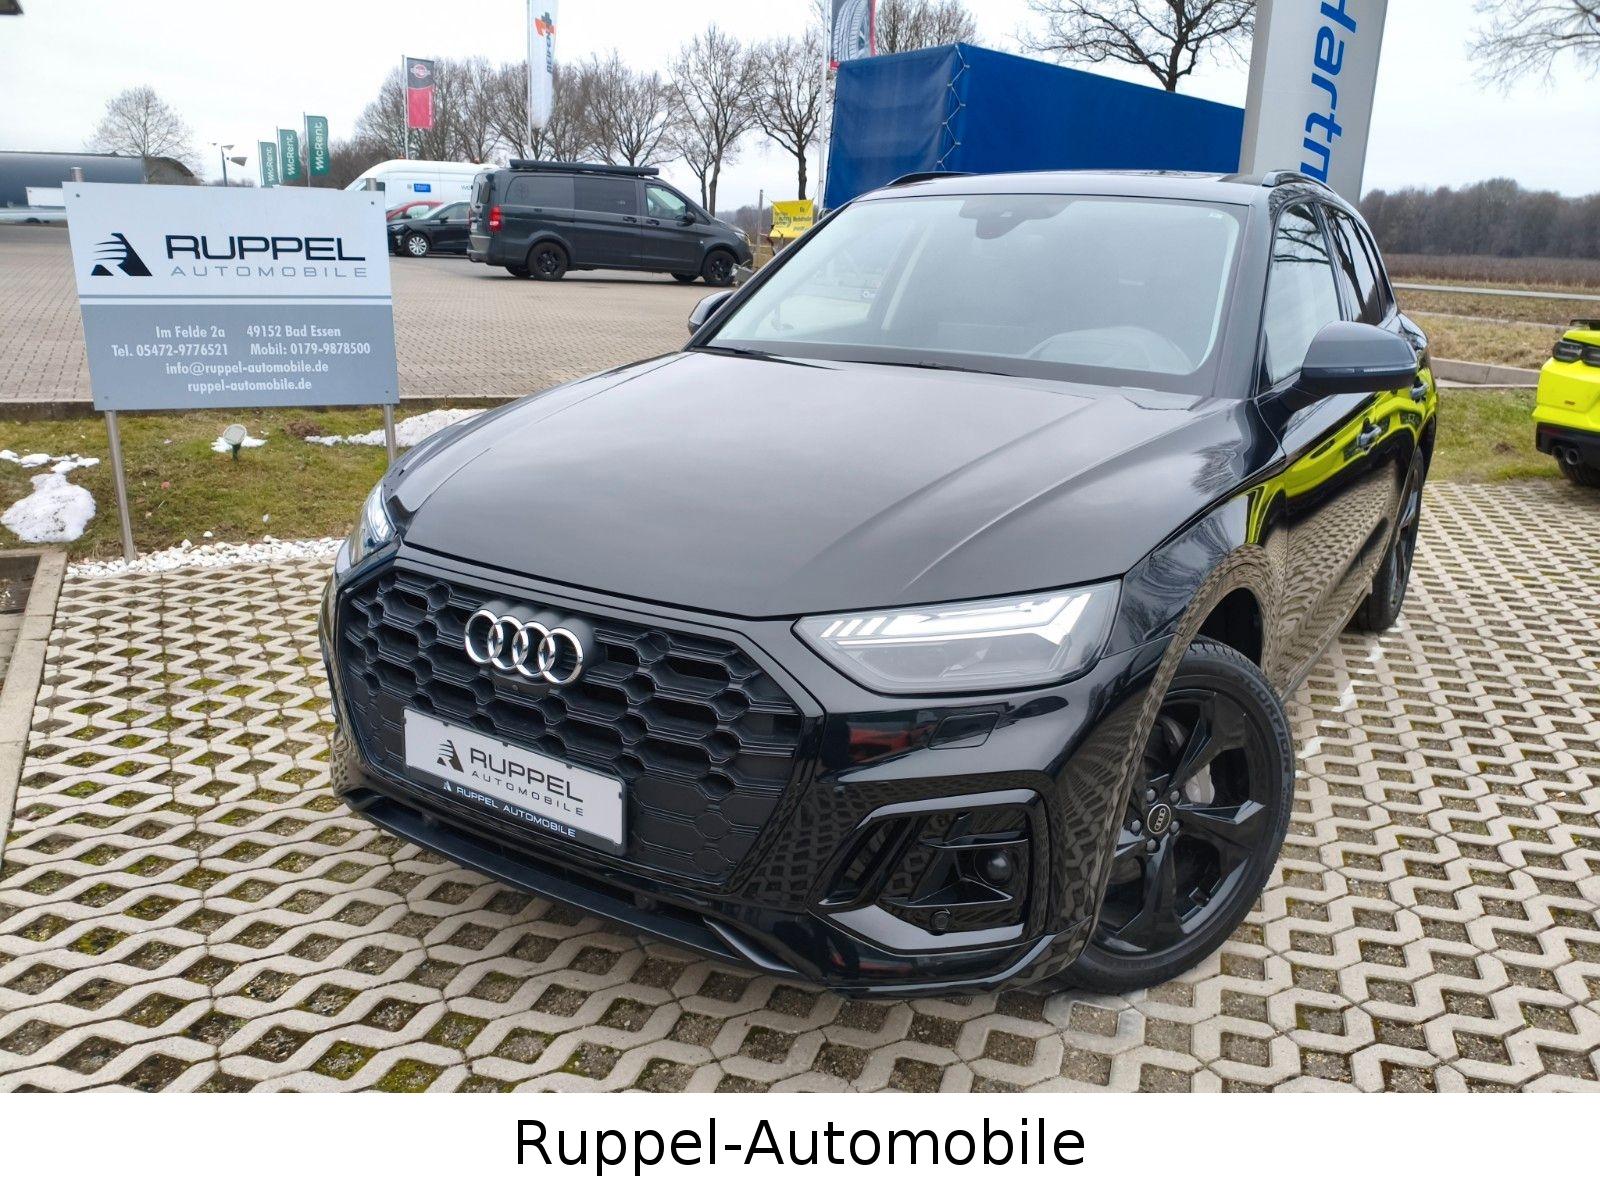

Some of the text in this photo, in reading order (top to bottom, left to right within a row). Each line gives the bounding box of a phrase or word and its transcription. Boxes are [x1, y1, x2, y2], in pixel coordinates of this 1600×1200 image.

[286, 133, 296, 176] McRent
[314, 121, 325, 171] McRent
[165, 234, 366, 262] RUPPEL
[170, 265, 368, 278] AUTOMOBILE
[155, 326, 226, 339] Im Felde 2a
[246, 325, 342, 338] 49152 Bad Essen
[111, 343, 229, 357] Tel. 05472-9776521
[250, 342, 371, 356] Mobil: 0179-9878500
[165, 360, 329, 376] info@ruppel-automobile.de
[187, 378, 312, 395] ruppel-automobile.de
[470, 747, 584, 803] RUPPEL
[471, 770, 584, 817] AUTOMOBILE
[456, 786, 576, 838] RUPPEL AUTOMOBILE
